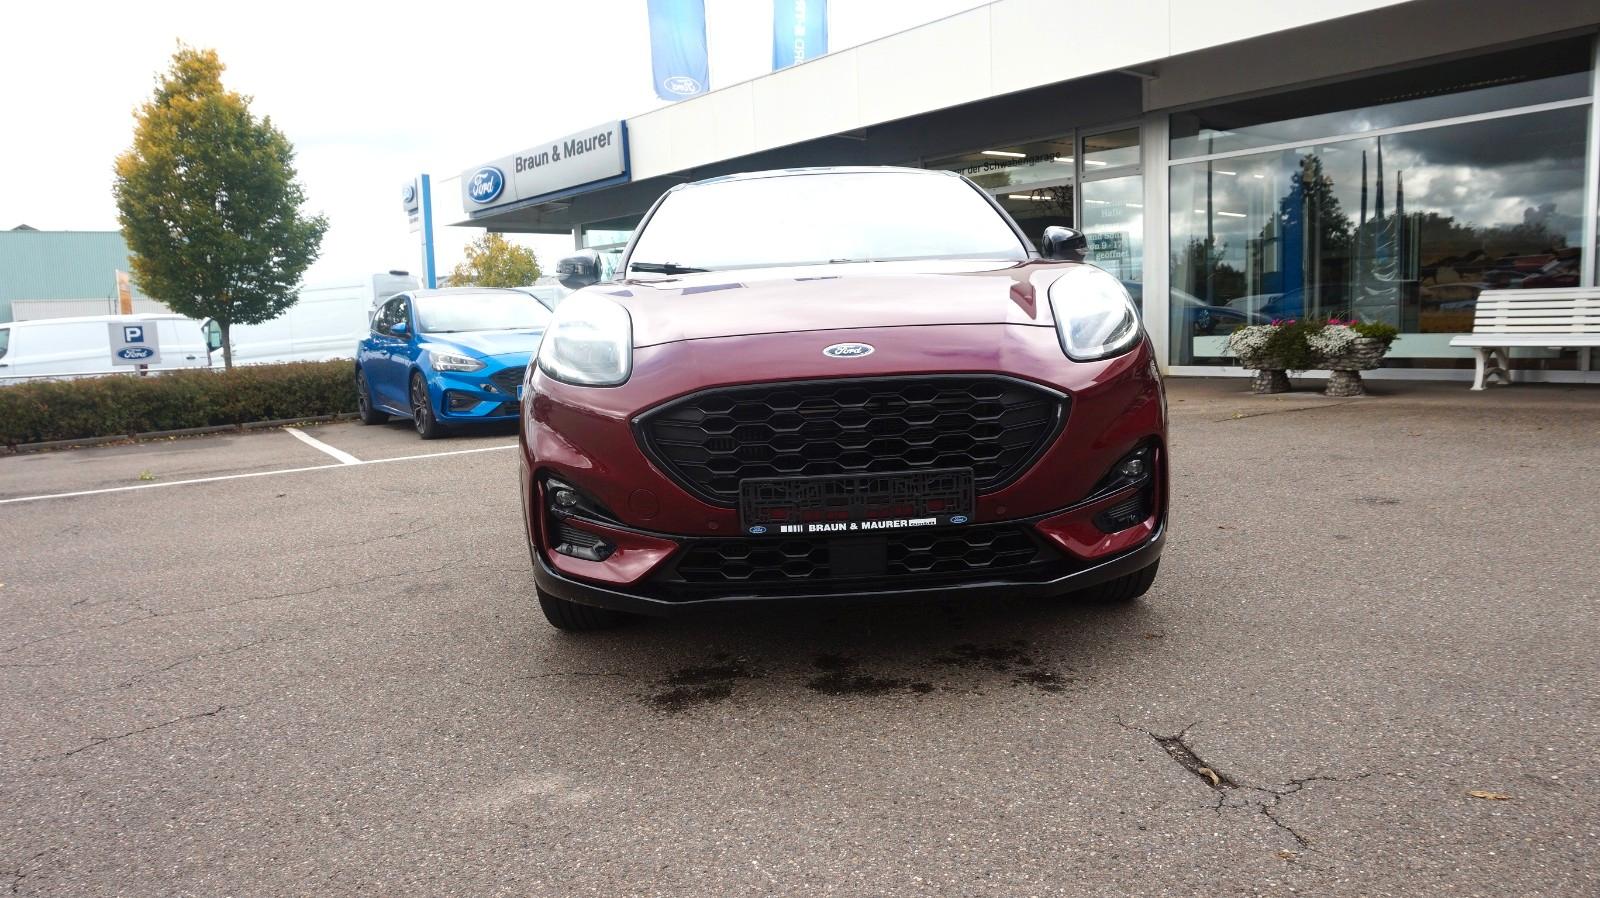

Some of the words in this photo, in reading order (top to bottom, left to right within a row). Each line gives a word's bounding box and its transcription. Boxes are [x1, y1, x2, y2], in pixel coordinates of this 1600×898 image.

[515, 152, 549, 173] Braun
[552, 145, 561, 162] &
[564, 130, 613, 159] Maurer
[967, 163, 981, 175] der
[983, 151, 1062, 172] Schwabengarage
[472, 172, 494, 197] Ford
[126, 328, 141, 342] P
[808, 523, 847, 532] BRAUN
[849, 522, 859, 530] &
[861, 519, 908, 530] MAURER
